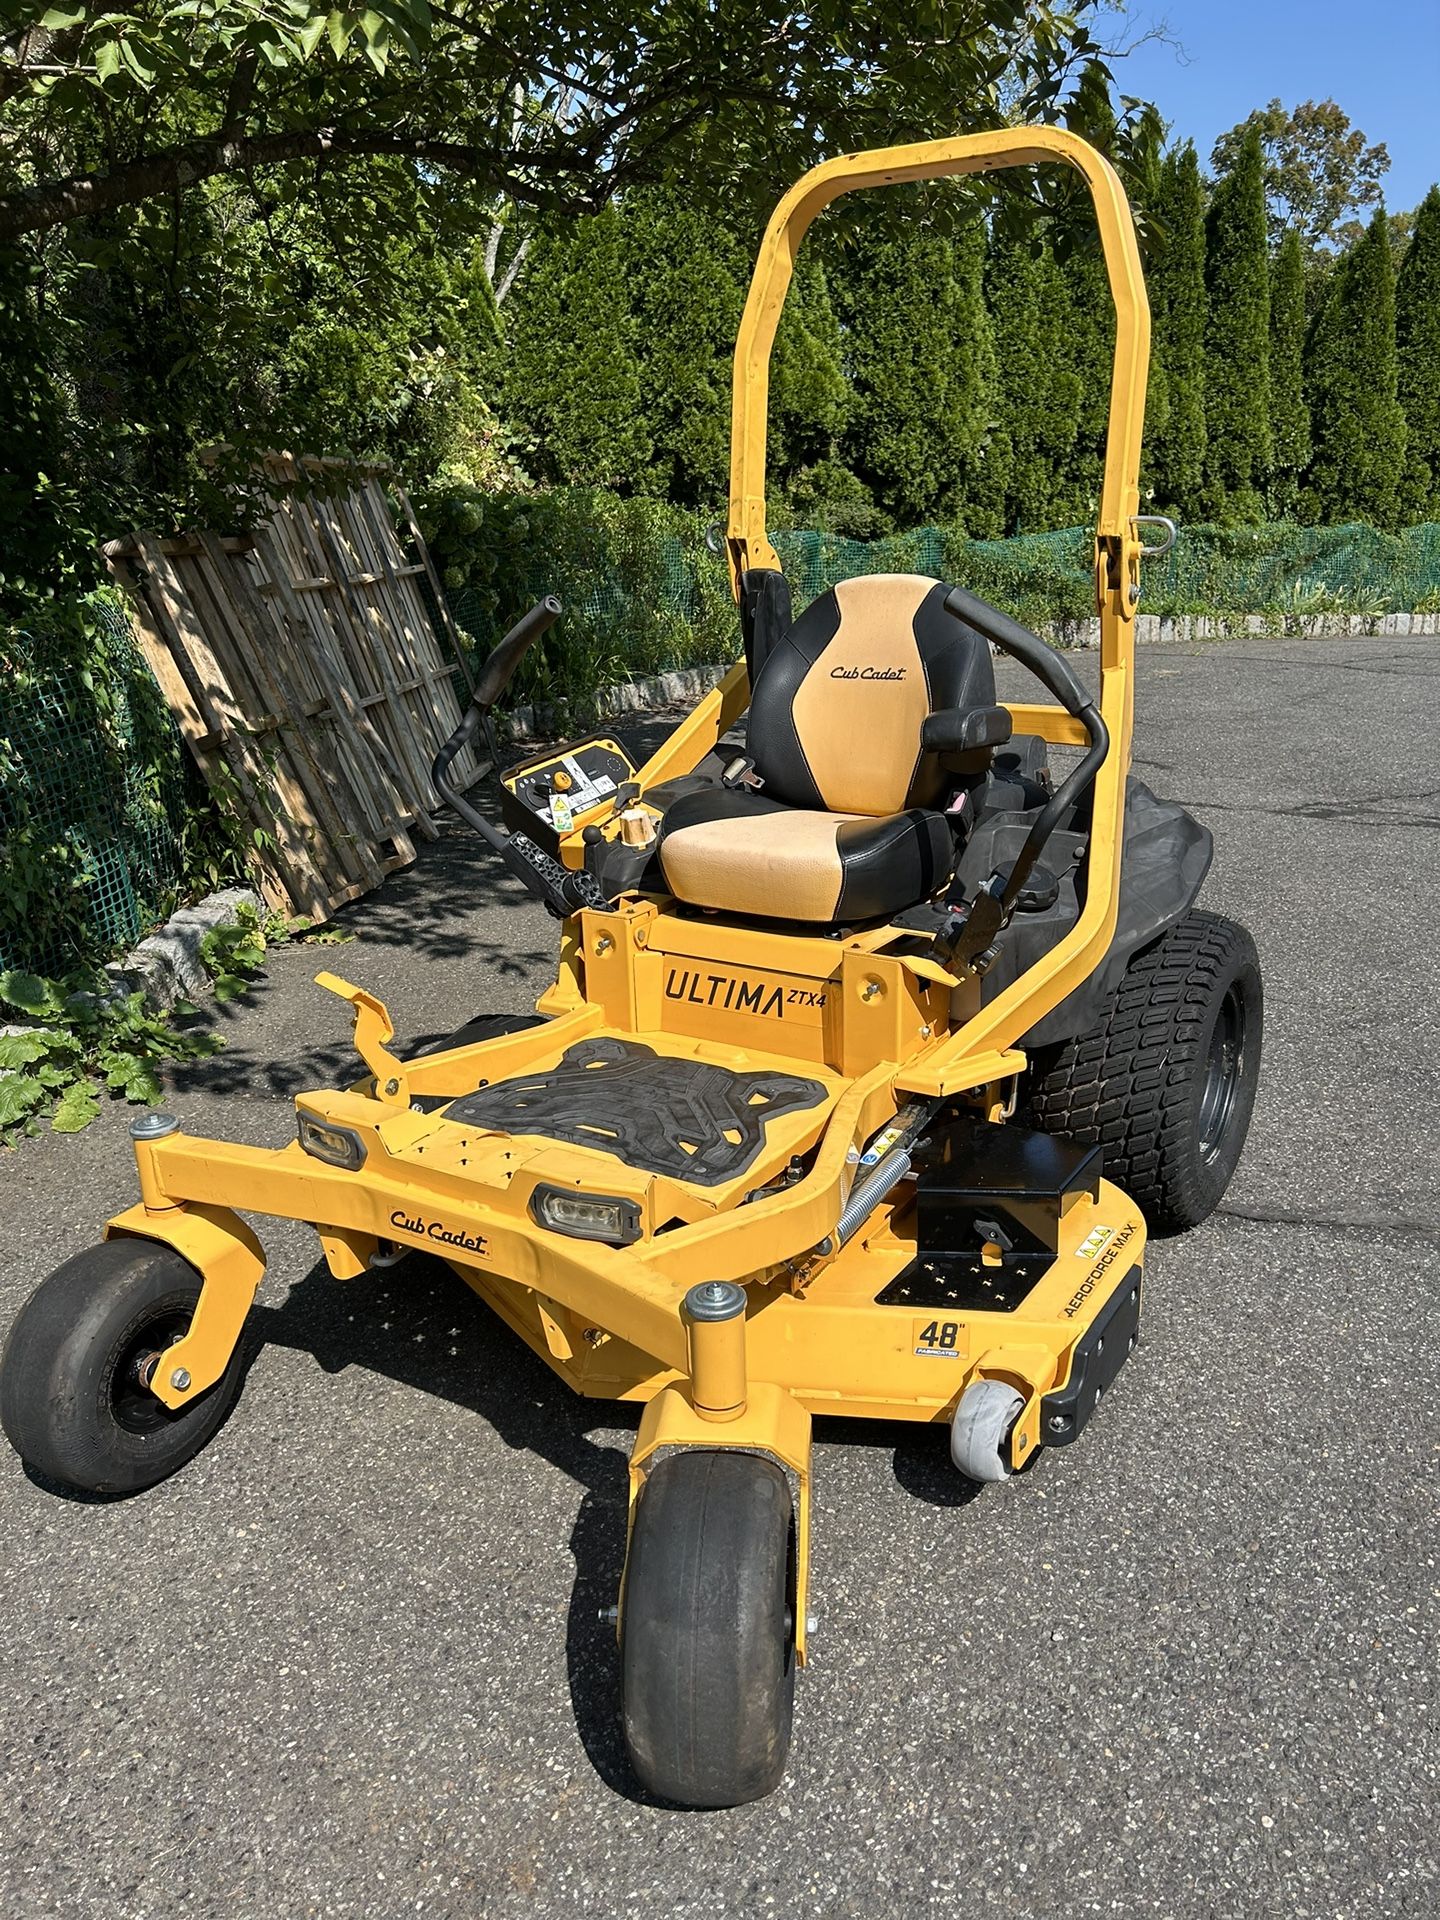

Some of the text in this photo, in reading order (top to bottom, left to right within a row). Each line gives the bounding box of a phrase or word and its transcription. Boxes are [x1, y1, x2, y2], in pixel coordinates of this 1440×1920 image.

[830, 666, 907, 681] Cub Cadet
[665, 969, 828, 1018] ULTIMA ZTX4
[390, 1210, 488, 1255] Cub Cadet
[1063, 1223, 1138, 1318] AEROFORCE MAX
